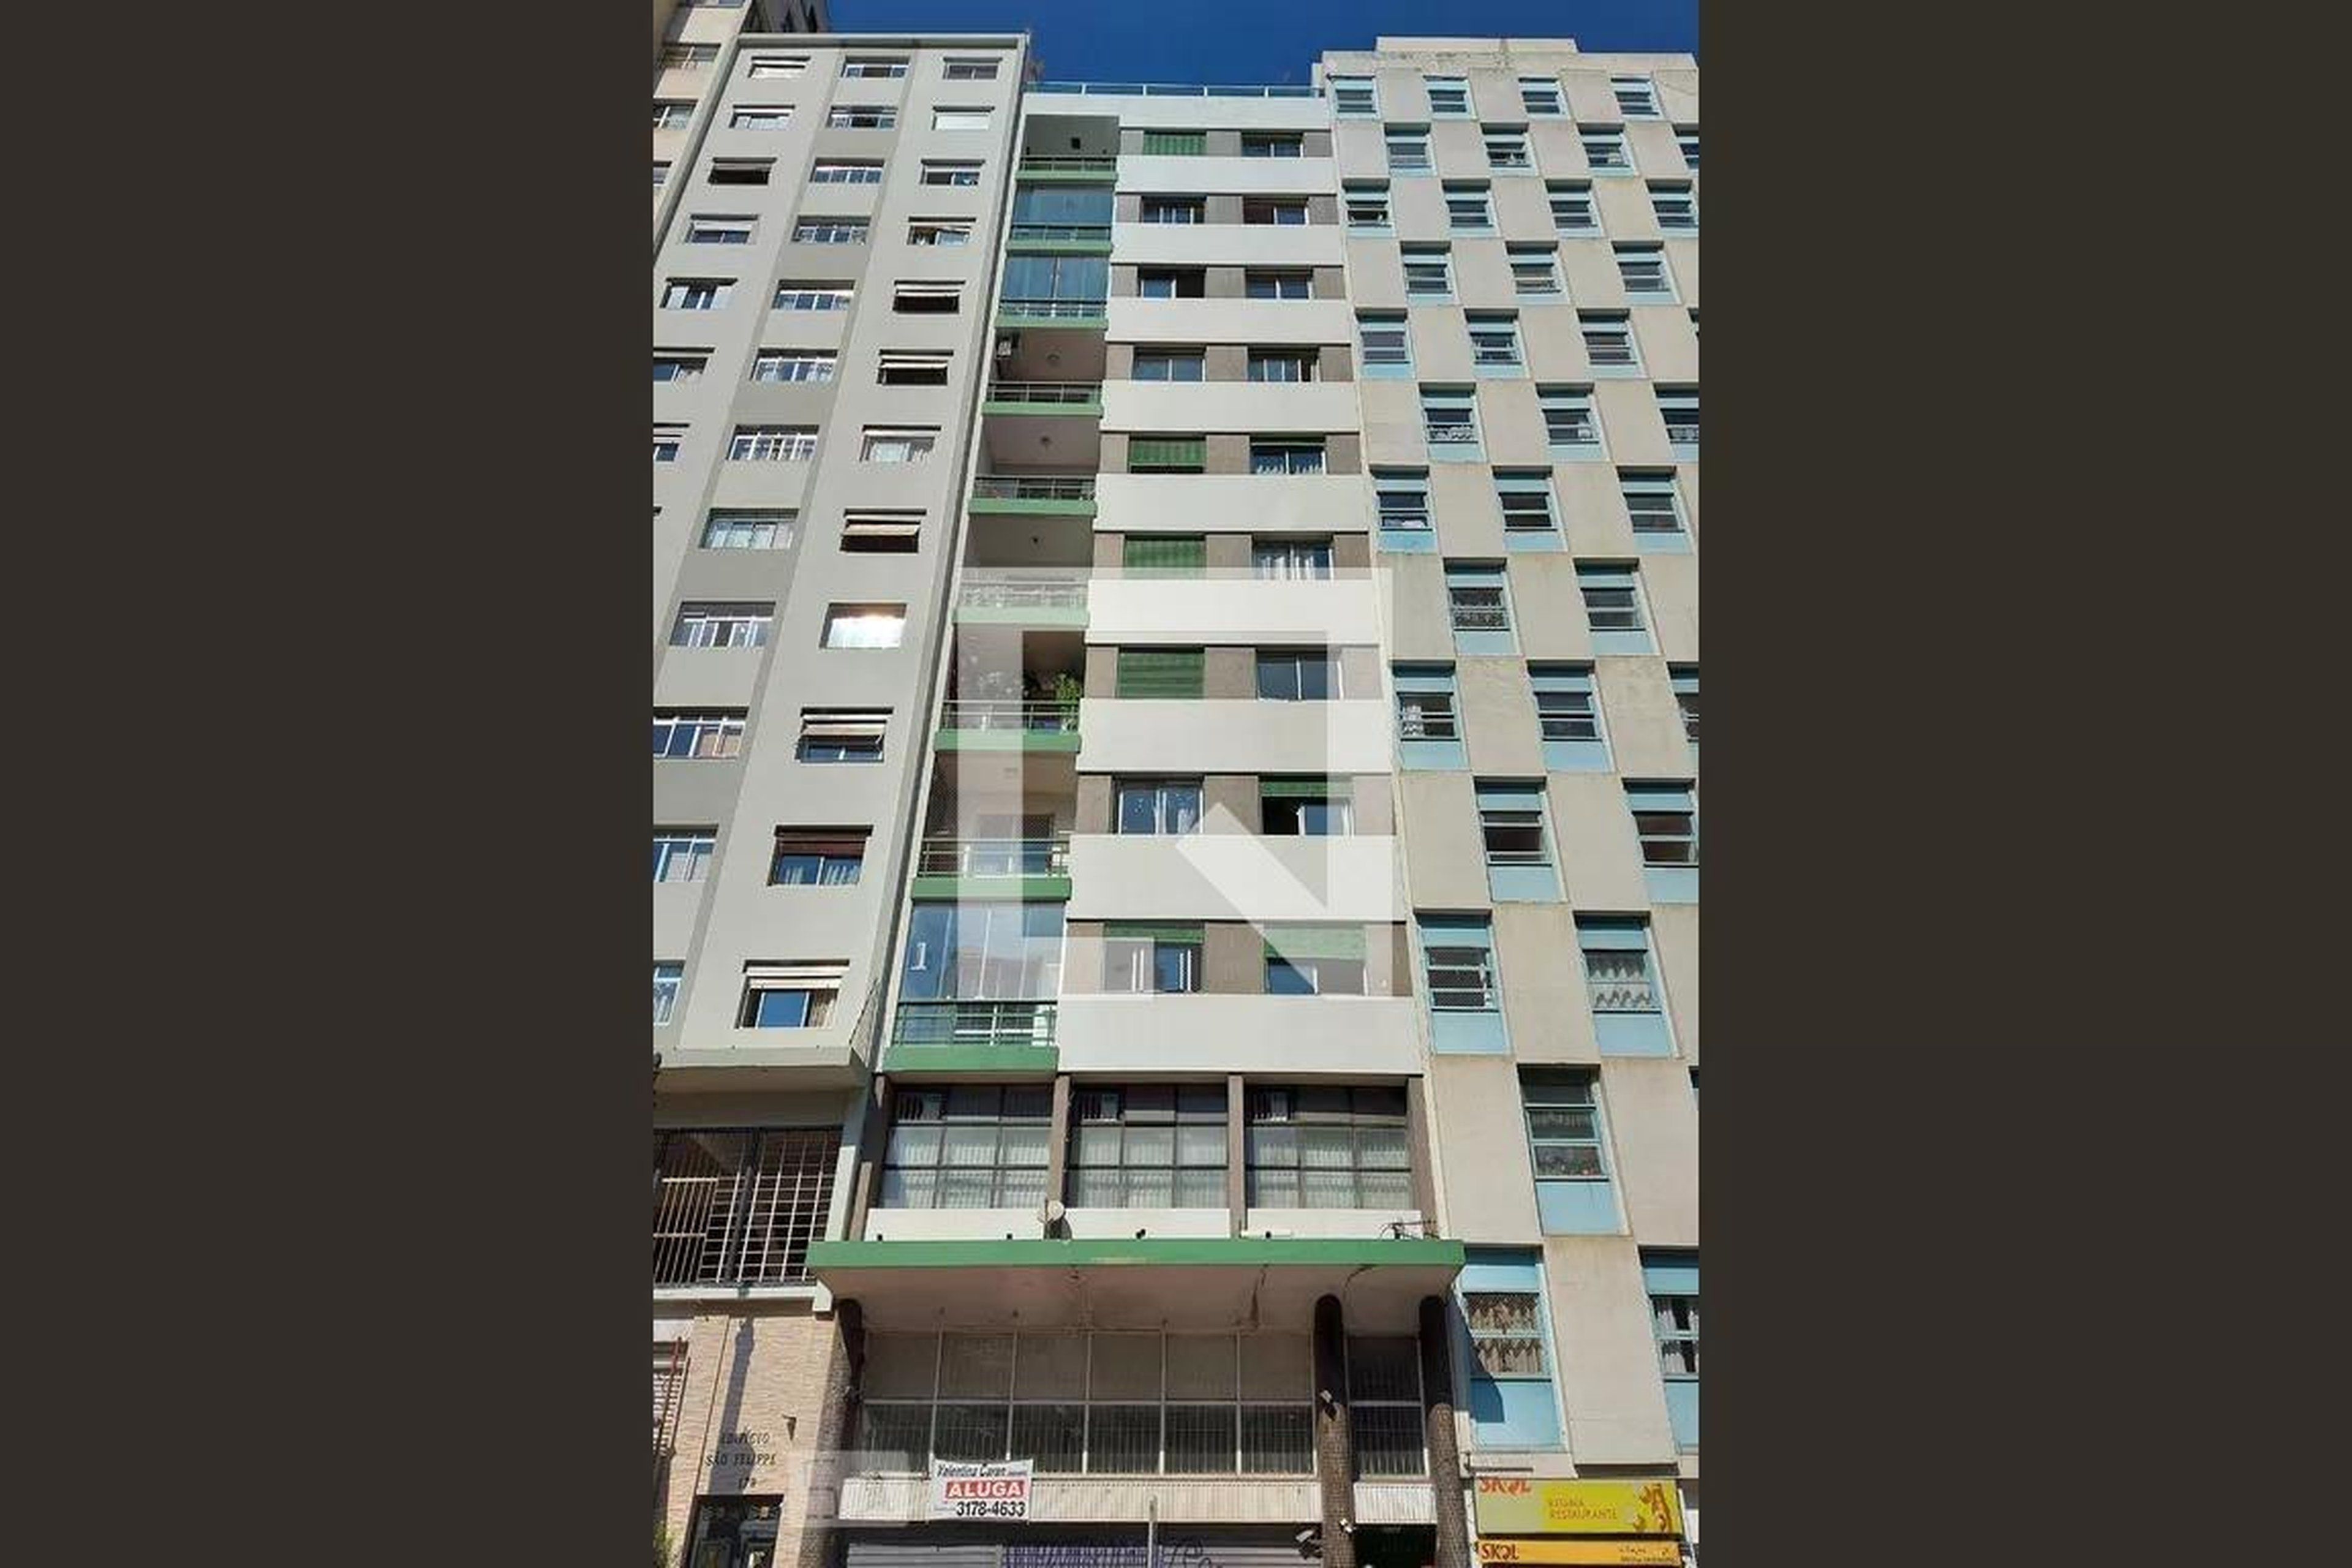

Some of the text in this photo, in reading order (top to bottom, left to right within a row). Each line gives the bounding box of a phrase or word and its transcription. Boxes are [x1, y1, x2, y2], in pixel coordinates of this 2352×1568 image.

[948, 1481, 1022, 1498] ALUGA
[957, 1501, 1025, 1517] 3178-4633
[1482, 1543, 1520, 1560] SKOL
